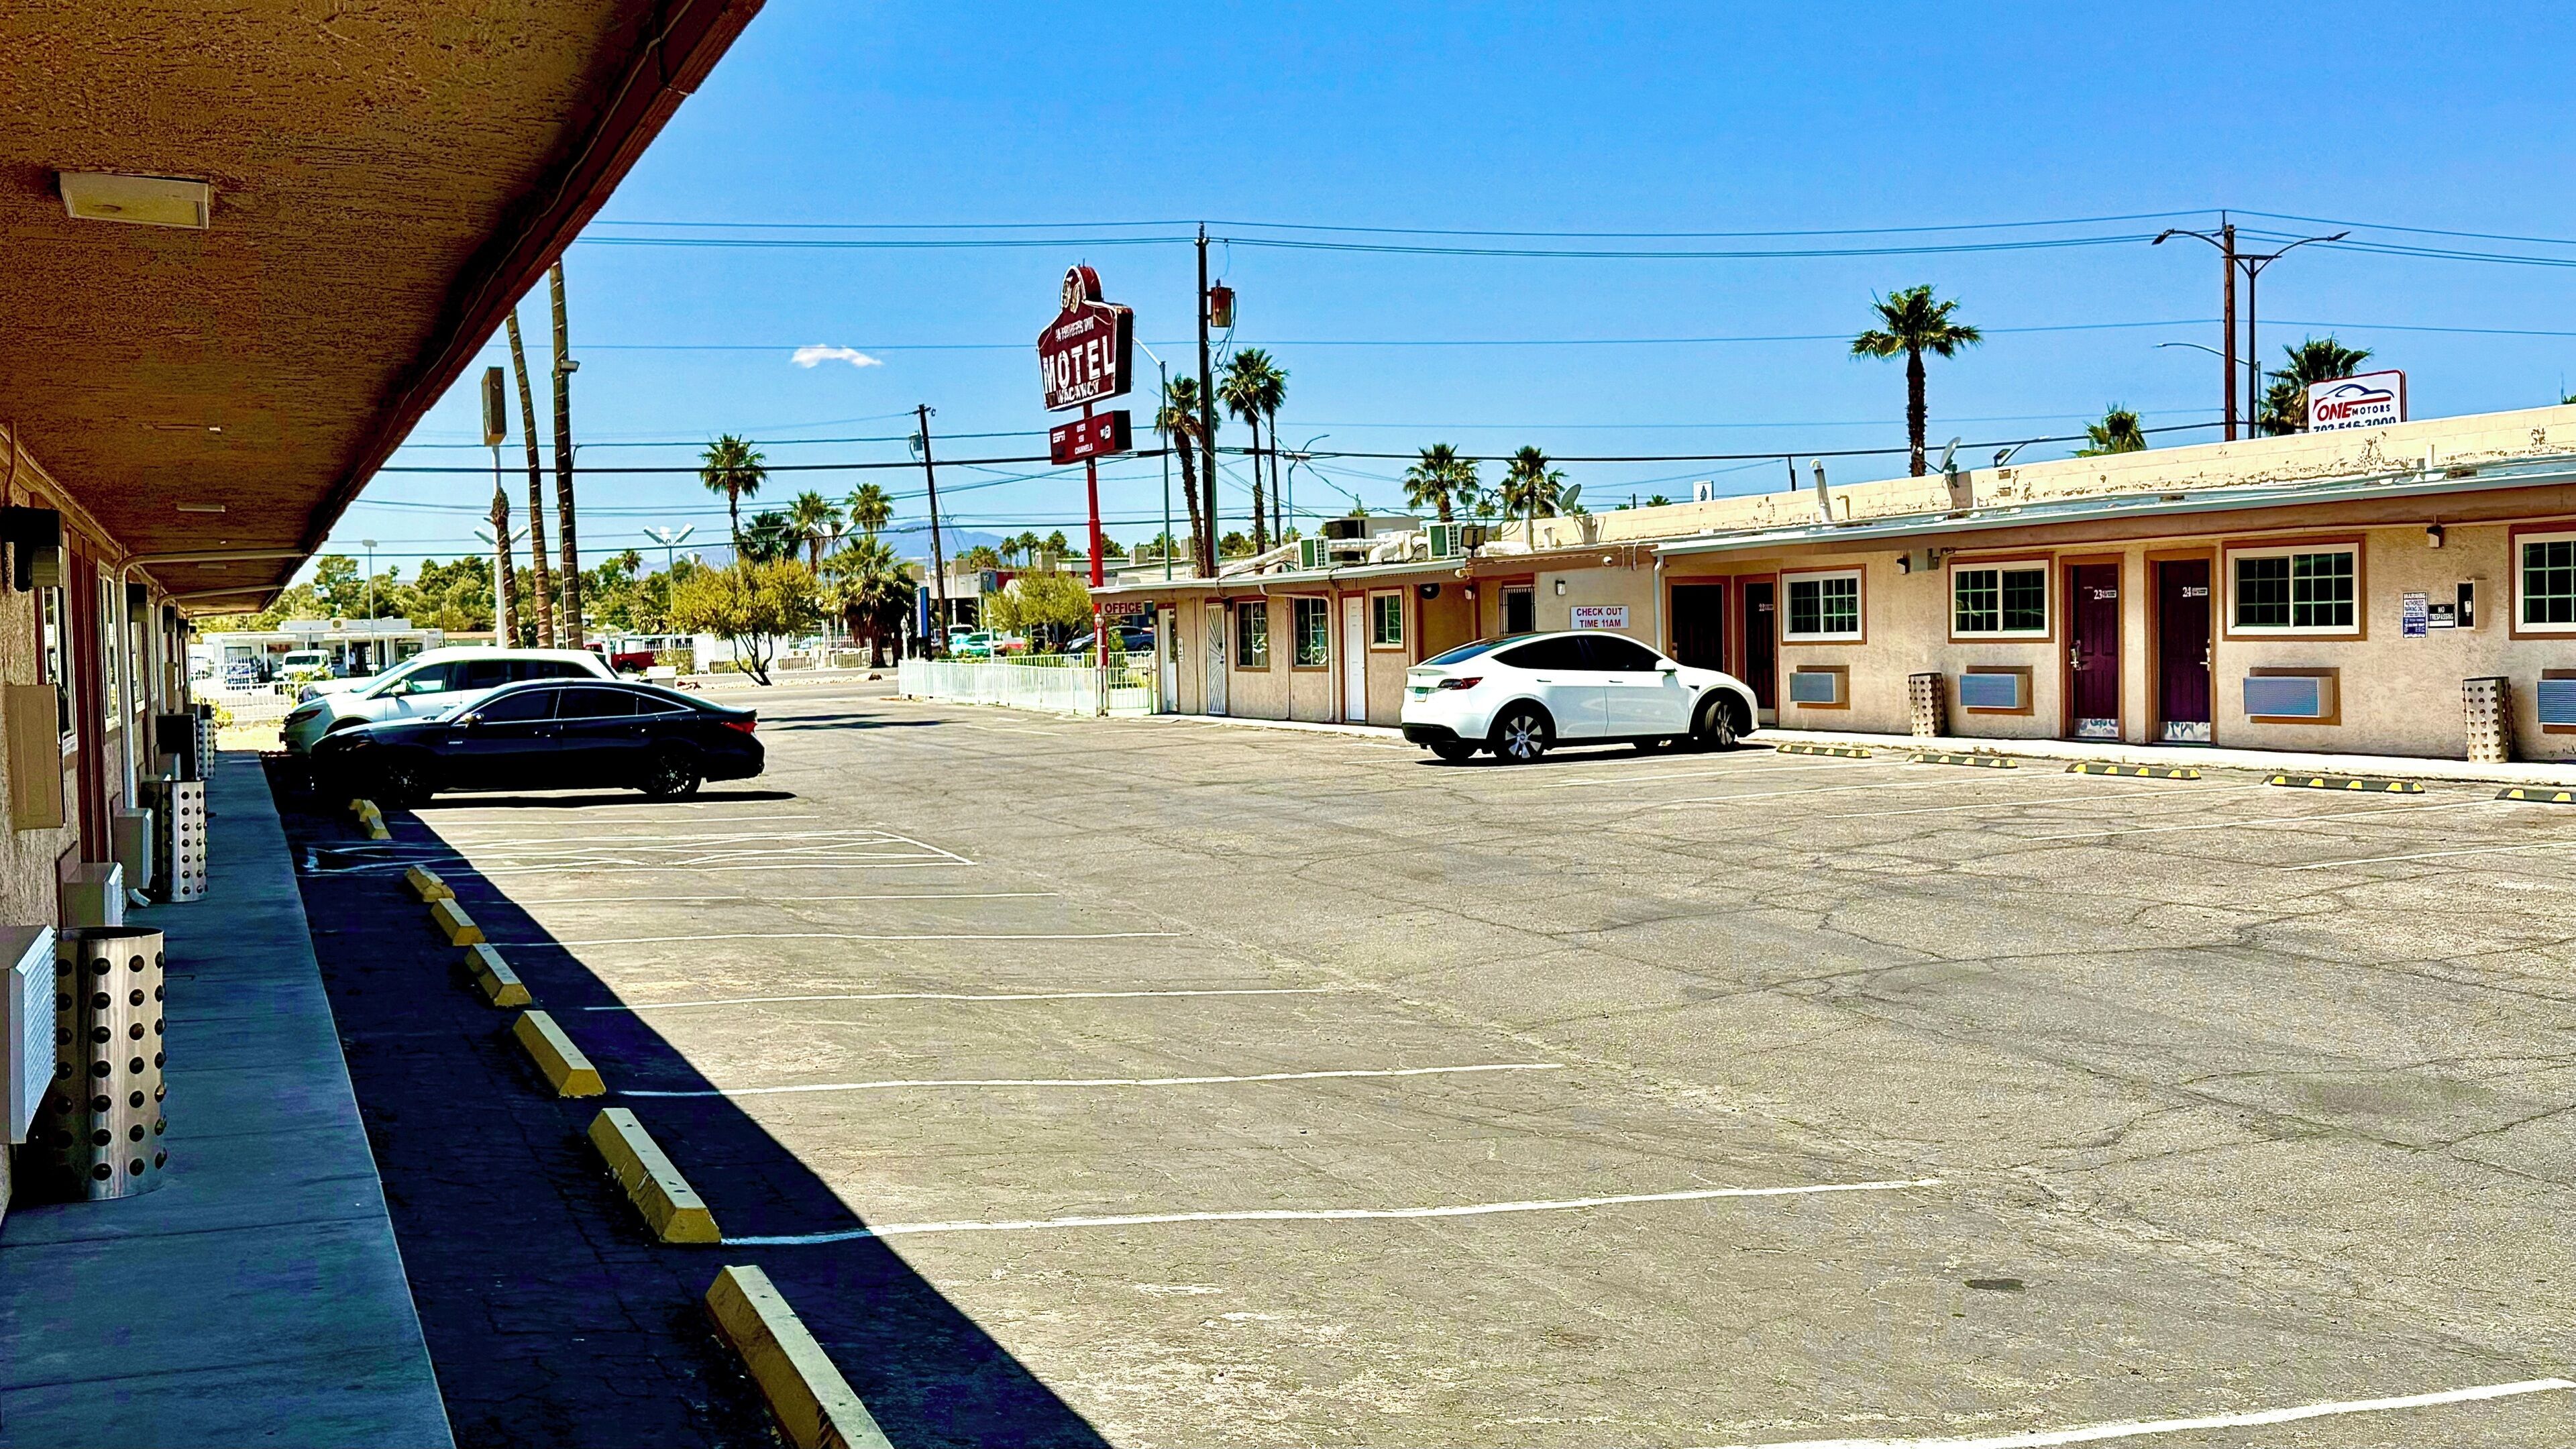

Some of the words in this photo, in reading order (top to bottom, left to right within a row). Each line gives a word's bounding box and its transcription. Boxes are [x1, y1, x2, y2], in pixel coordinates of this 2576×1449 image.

[1042, 335, 1114, 394] MOTEL
[1057, 378, 1101, 404] VACANCY
[2317, 402, 2353, 421] ONE
[2353, 404, 2390, 416] MOTORS
[2094, 590, 2102, 600] 23
[2182, 586, 2192, 597] 24
[1105, 602, 1142, 613] OFFICE
[1576, 608, 1603, 616] CHECK
[1579, 620, 1598, 628] TIME
[1602, 619, 1621, 627] 11AM
